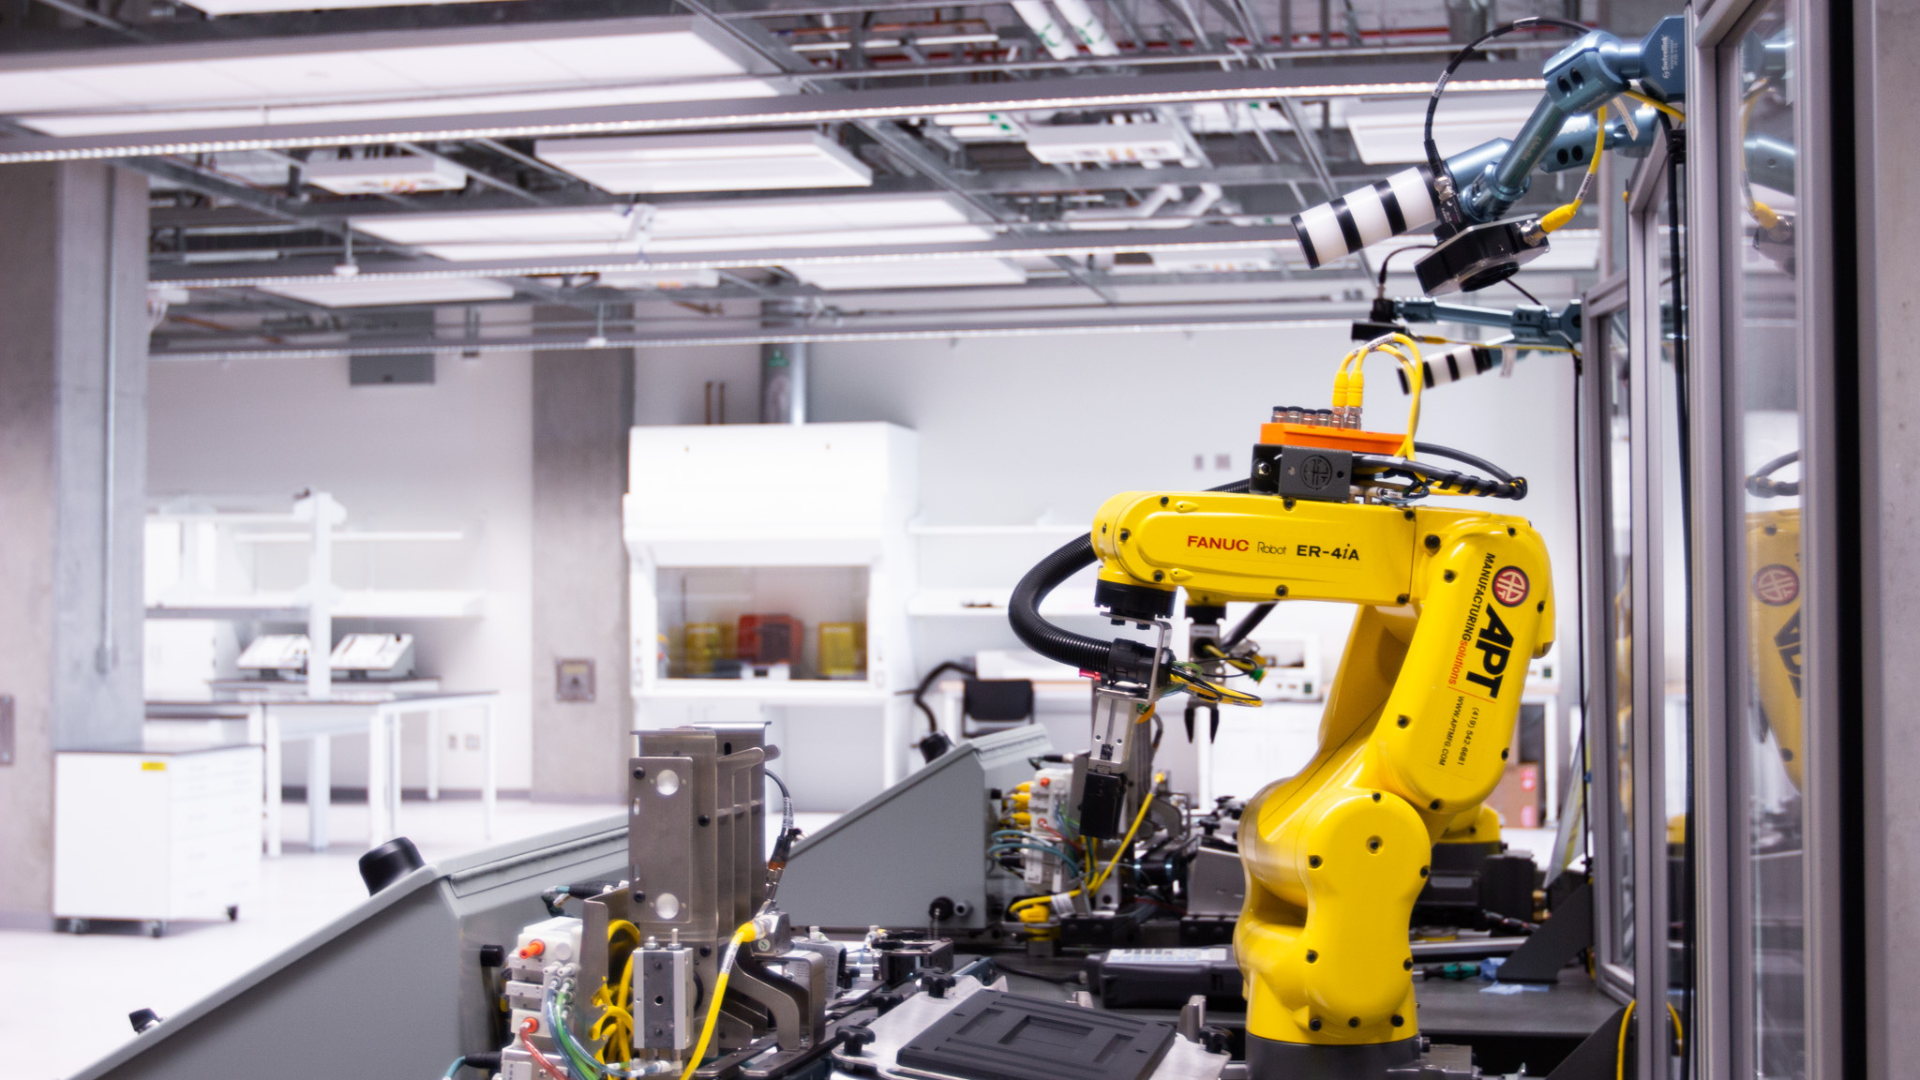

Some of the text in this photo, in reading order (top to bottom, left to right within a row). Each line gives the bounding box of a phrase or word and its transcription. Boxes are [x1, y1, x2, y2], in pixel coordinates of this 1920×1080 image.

[1187, 535, 1360, 561] FANUC Robot ER-4iA
[1466, 603, 1514, 698] APT
[1438, 696, 1465, 766] WWW.APTMFG.COM
[1467, 707, 1480, 728] (419)
